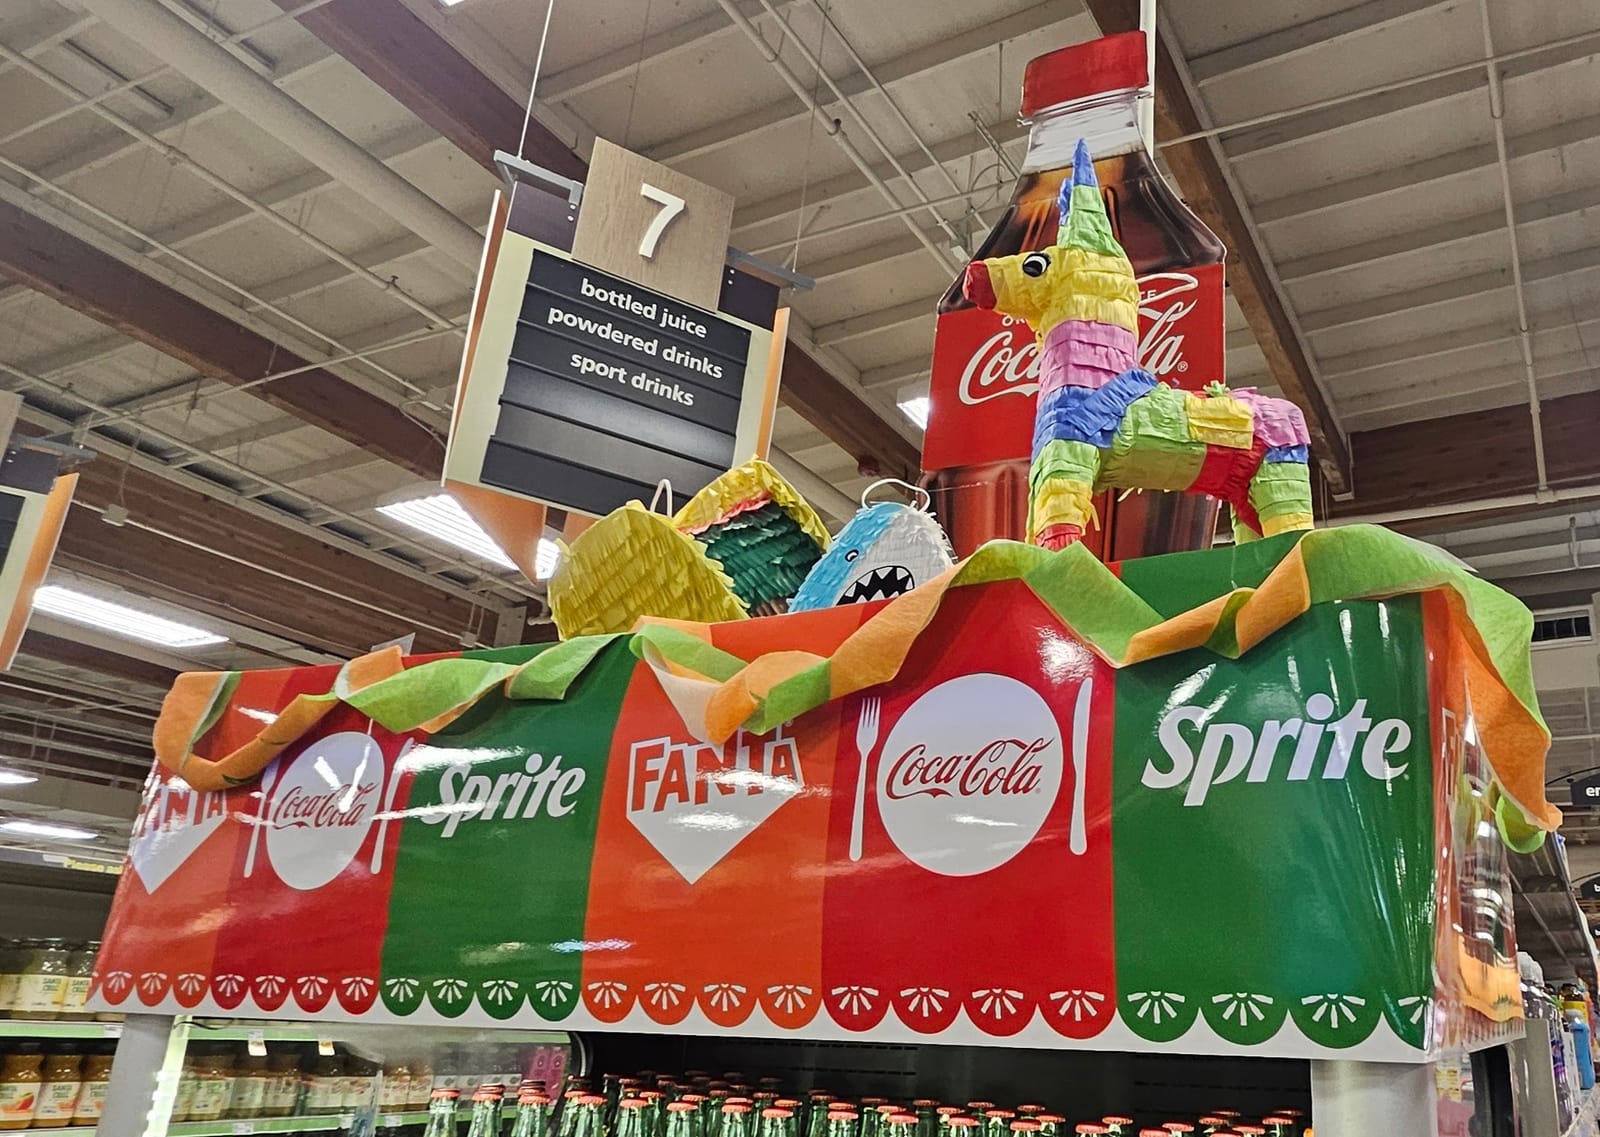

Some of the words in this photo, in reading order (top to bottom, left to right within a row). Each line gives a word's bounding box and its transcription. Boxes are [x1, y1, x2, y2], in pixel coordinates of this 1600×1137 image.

[638, 183, 686, 258] 7
[547, 306, 658, 356] powdered
[662, 346, 723, 379] drinks
[580, 278, 657, 320] bottled
[659, 308, 707, 338] juice
[570, 353, 627, 384] sport
[631, 372, 694, 406] drinks
[630, 727, 800, 813] FANTA
[886, 736, 1056, 800] Coca-Cola
[1140, 692, 1413, 807] Sprite
[272, 782, 379, 830] Coca-Cola
[420, 753, 586, 838] Sprite
